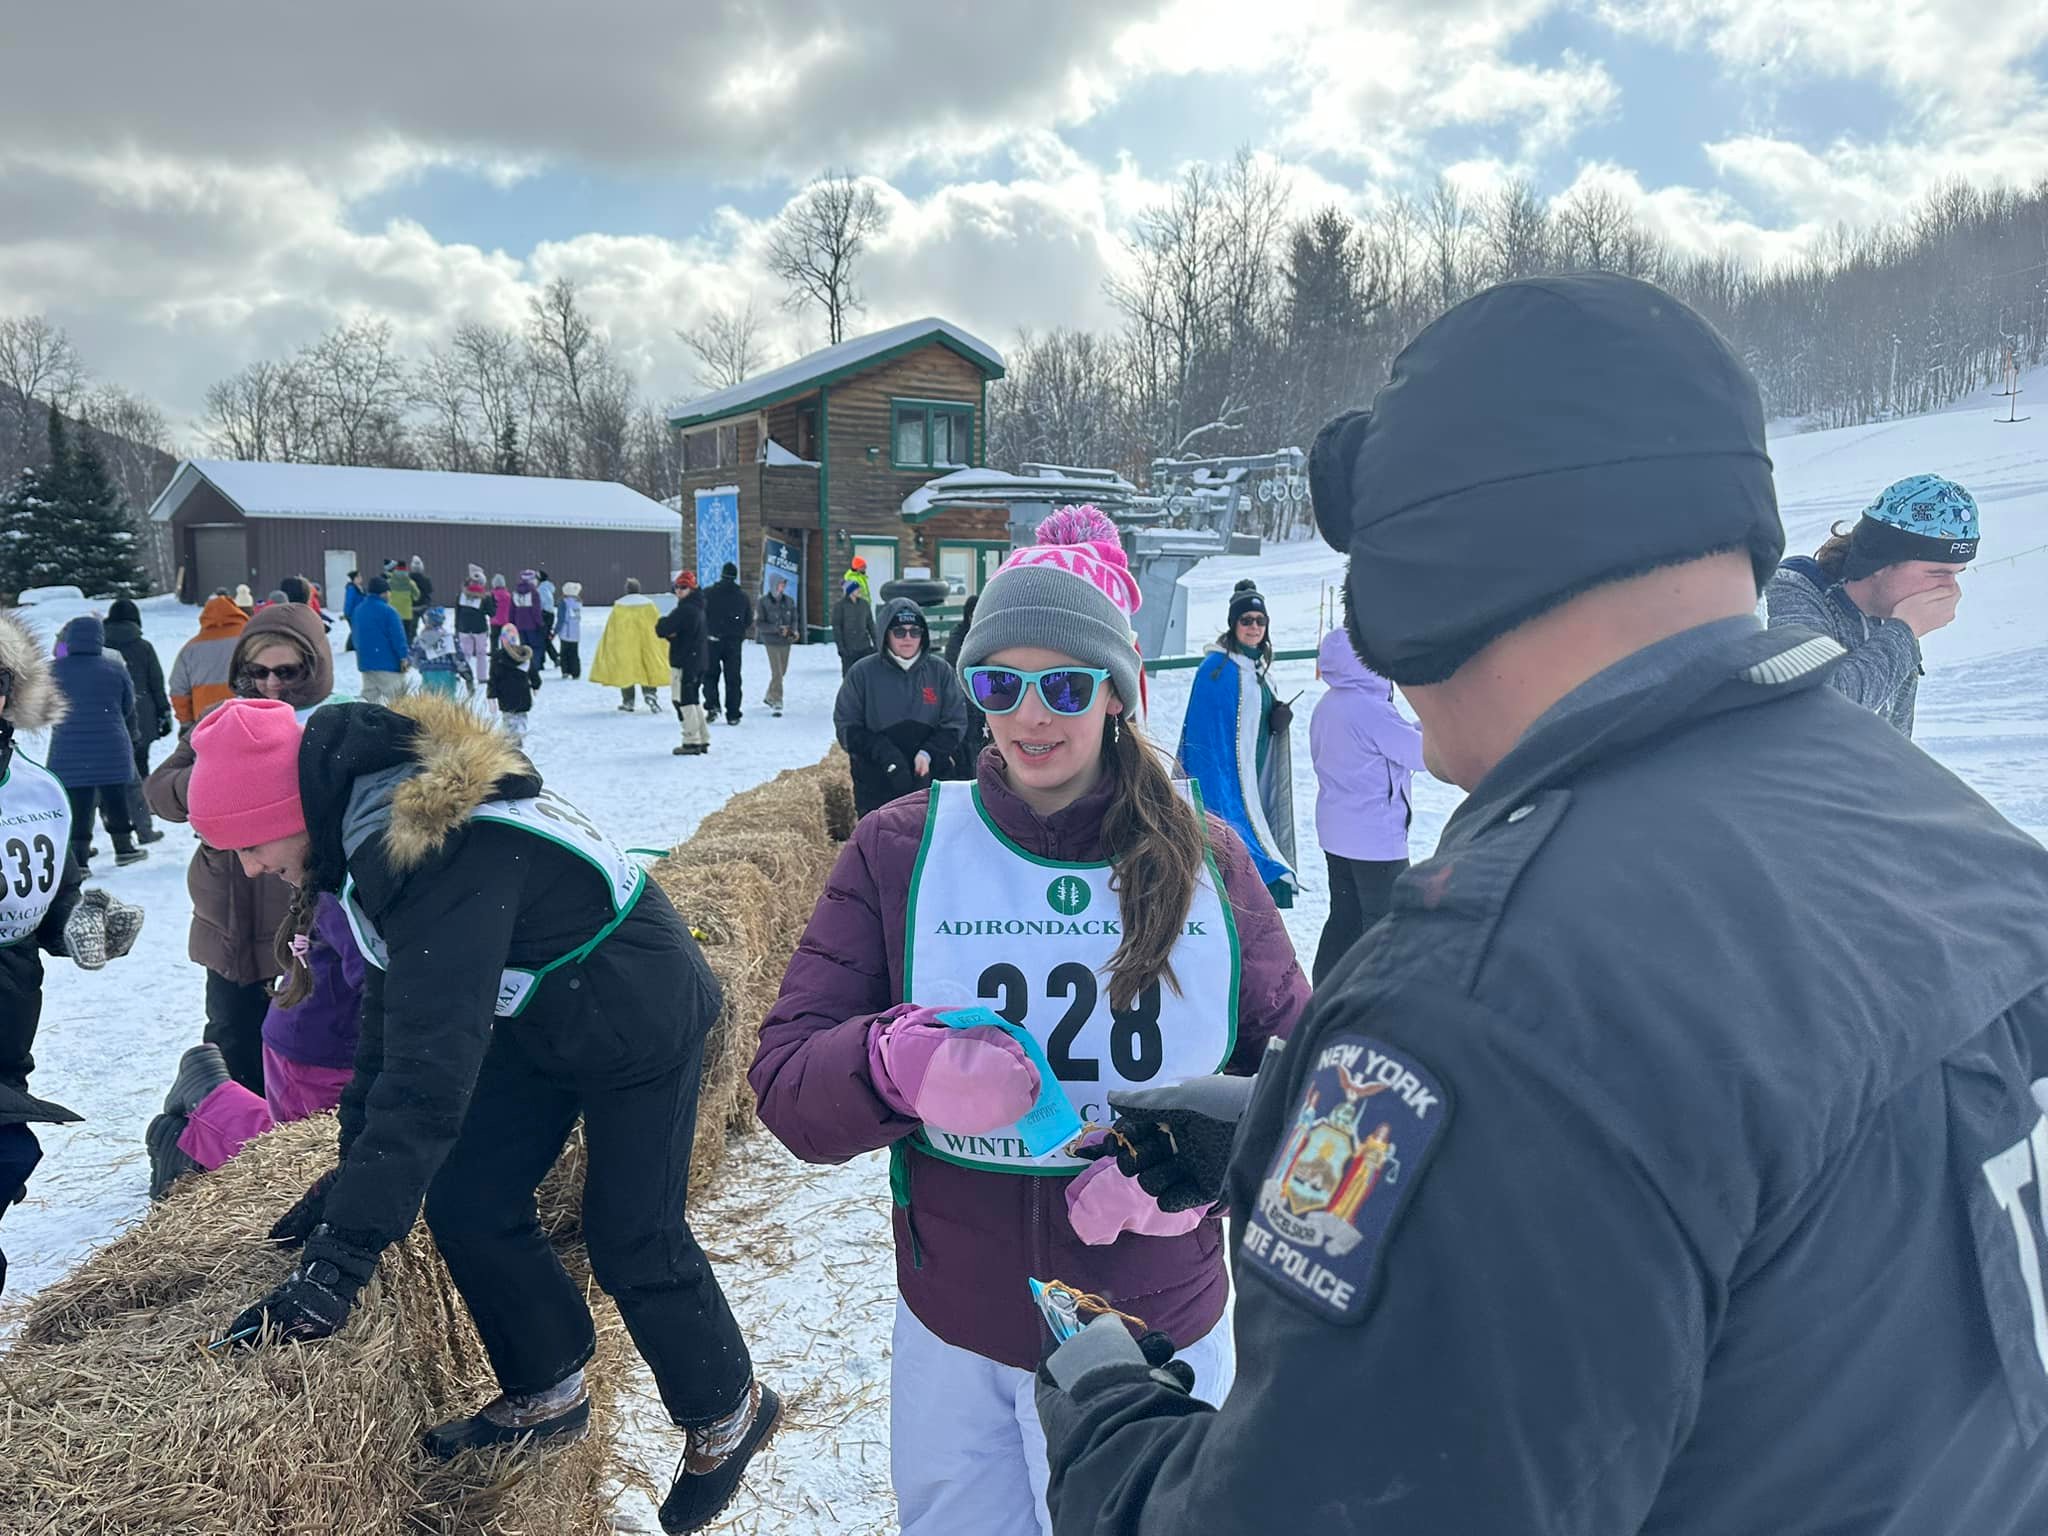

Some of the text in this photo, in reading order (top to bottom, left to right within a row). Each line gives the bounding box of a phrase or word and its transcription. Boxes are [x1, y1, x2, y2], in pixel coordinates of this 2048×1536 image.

[28, 808, 63, 822] BANK
[935, 920, 1120, 936] ADIRONDACK
[976, 962, 1163, 1082] 328
[1317, 1044, 1439, 1120] NEW YORK
[942, 1132, 1056, 1158] WINTE
[1270, 1240, 1356, 1311] POLICE
